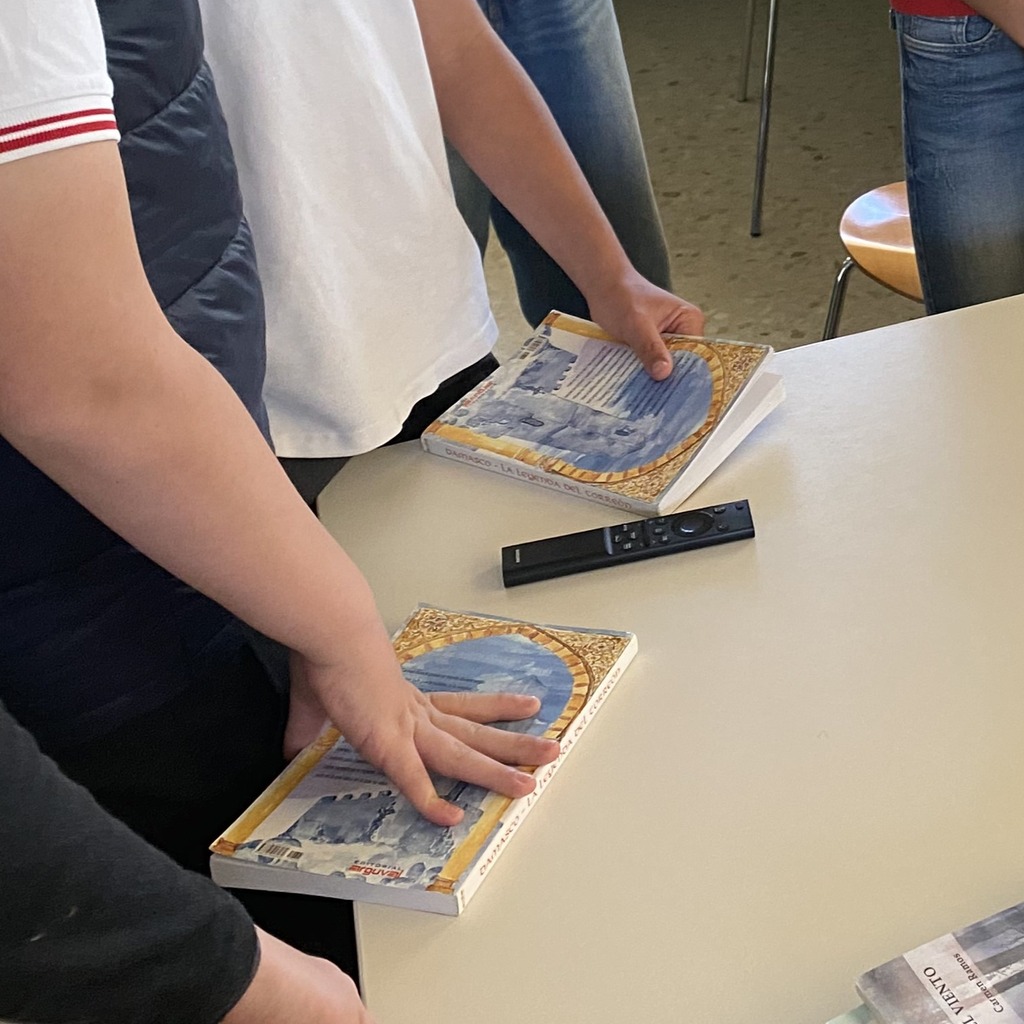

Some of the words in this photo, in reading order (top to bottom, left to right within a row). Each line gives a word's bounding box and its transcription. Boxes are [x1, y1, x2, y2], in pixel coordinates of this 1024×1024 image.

[446, 448, 491, 467] DAMASCO
[348, 865, 404, 878] arguval
[953, 953, 976, 983] Ramos
[923, 966, 964, 1016] VIENTO
[977, 981, 1004, 1013] Carmen
